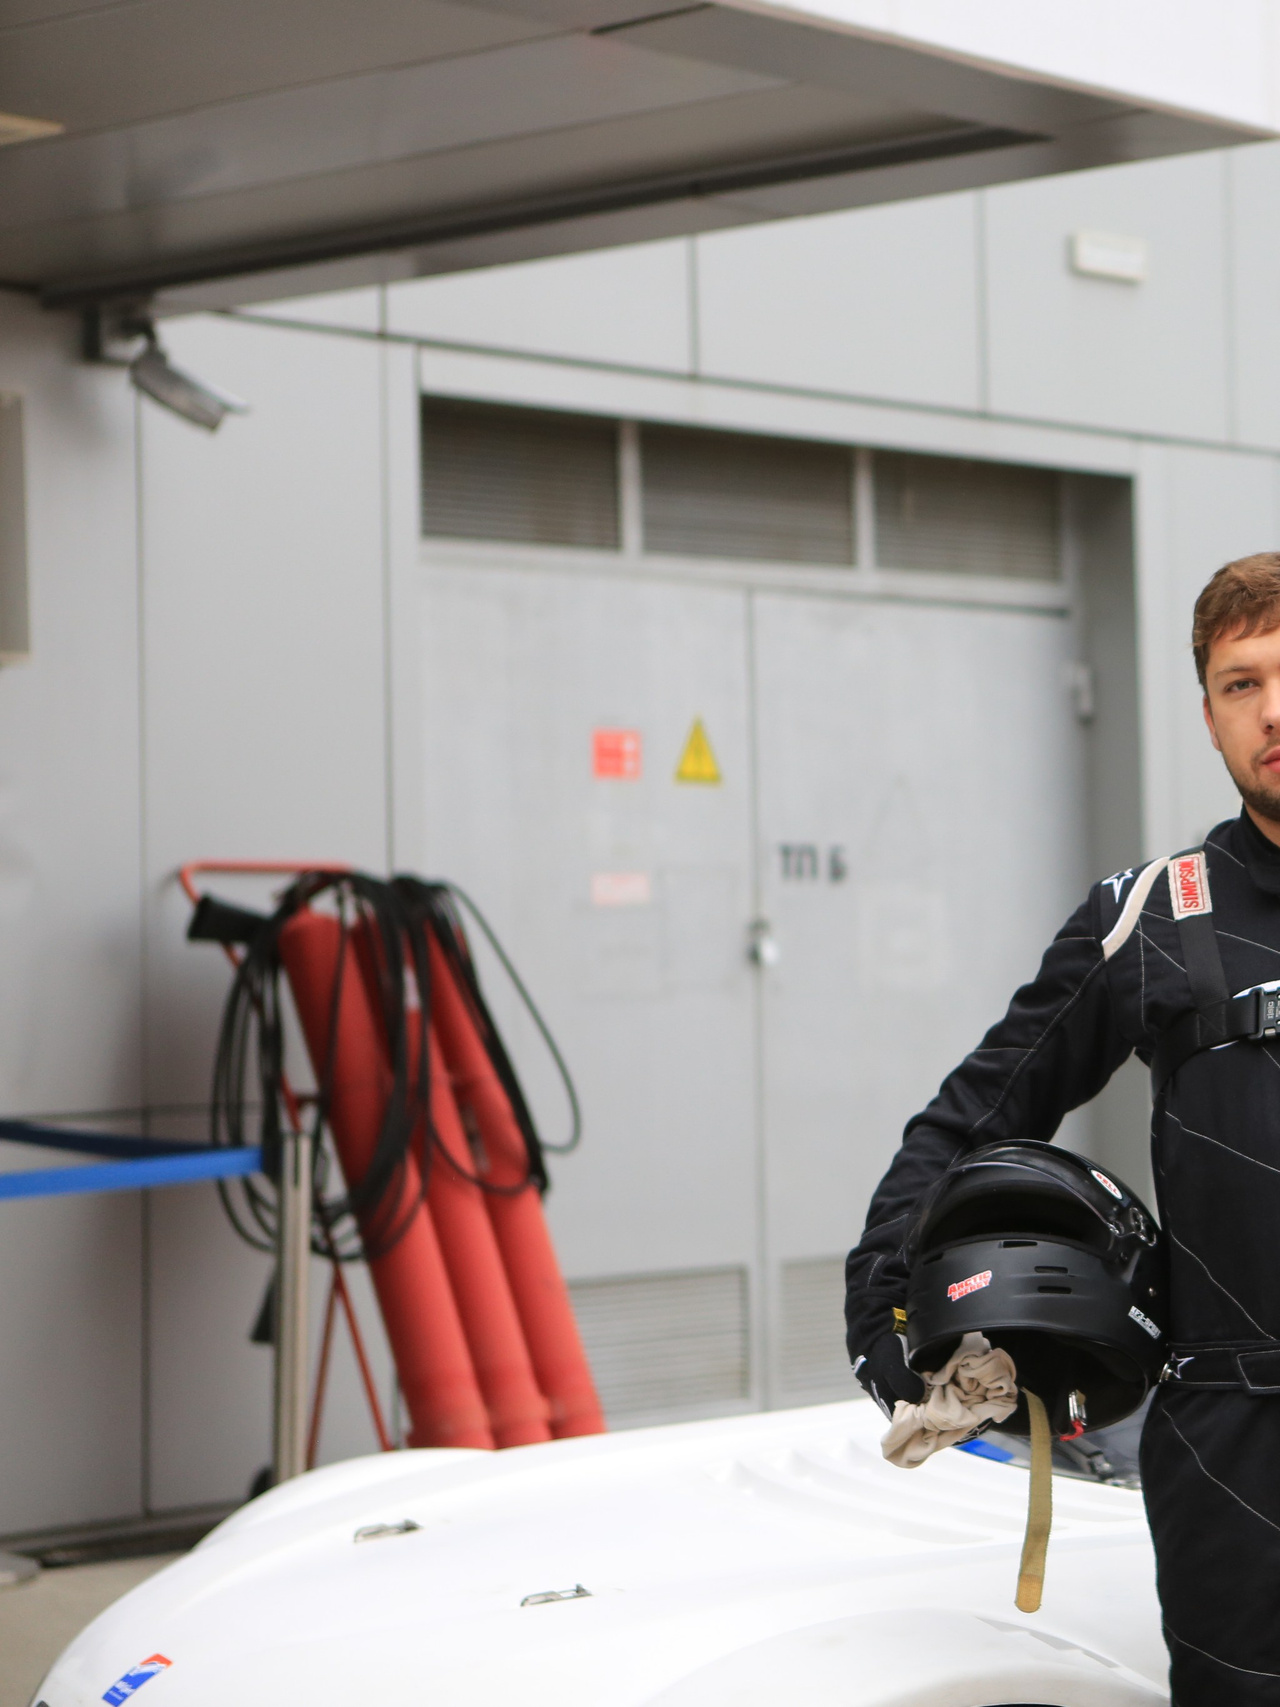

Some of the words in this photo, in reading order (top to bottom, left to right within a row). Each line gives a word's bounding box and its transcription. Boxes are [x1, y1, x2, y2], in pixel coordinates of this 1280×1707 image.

[1178, 859, 1199, 909] SIMPSON
[948, 1270, 992, 1297] ARCTIC
[952, 1279, 990, 1301] ENERGY
